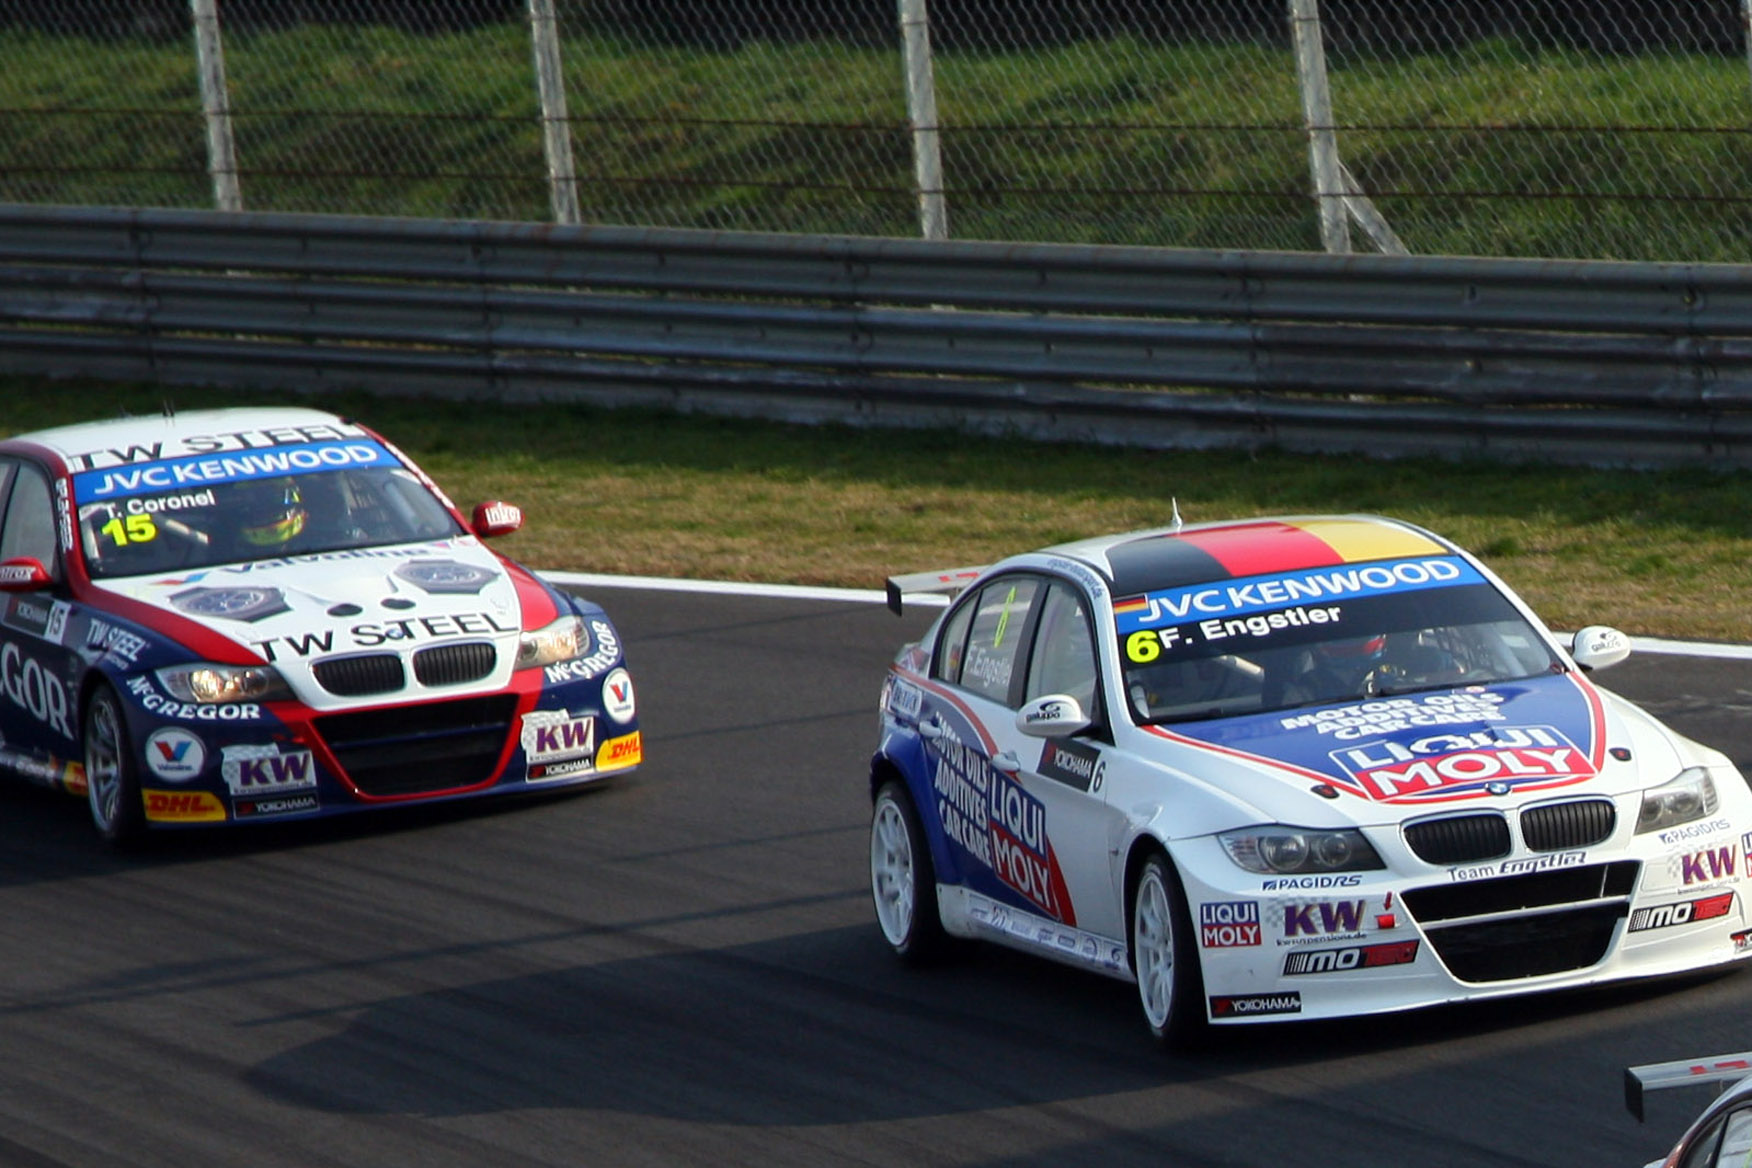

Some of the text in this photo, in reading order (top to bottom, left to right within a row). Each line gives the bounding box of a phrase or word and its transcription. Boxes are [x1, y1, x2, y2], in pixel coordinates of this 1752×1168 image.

[181, 424, 370, 454] STEEL
[127, 489, 216, 515] Coronel
[102, 513, 157, 547] 15
[108, 627, 146, 662] STEEL
[250, 611, 521, 663] TW STEEL
[1161, 605, 1342, 650] F. Engstler
[1125, 629, 1162, 665] 6
[0, 641, 74, 740] GOR
[1279, 690, 1505, 731] MOTOR OILS
[1317, 699, 1503, 735] ADDITIVES
[1334, 709, 1506, 741] CAR CARE
[536, 718, 591, 753] KW
[1346, 727, 1559, 771] LIQUI
[239, 752, 311, 787] KW
[545, 758, 591, 776] YOKOHAMA
[966, 747, 988, 793] OILS
[1054, 748, 1093, 778] YOKOHAMA
[1093, 761, 1106, 792] 6
[1368, 748, 1575, 797] MOLY
[149, 793, 216, 814] DHL
[256, 796, 316, 813] YOKOHAMA
[934, 757, 988, 830] ADDITIVES
[990, 772, 1045, 855] LIQUI
[938, 799, 993, 870] CAR CARE
[993, 828, 1051, 909] MOLY
[1447, 851, 1588, 883] Team Engstler
[1681, 844, 1737, 887] KW
[1202, 902, 1258, 925] LIQUI
[1284, 900, 1368, 938] KW
[1203, 925, 1261, 948] MOLY
[1230, 997, 1302, 1013] YOKOHAMA
